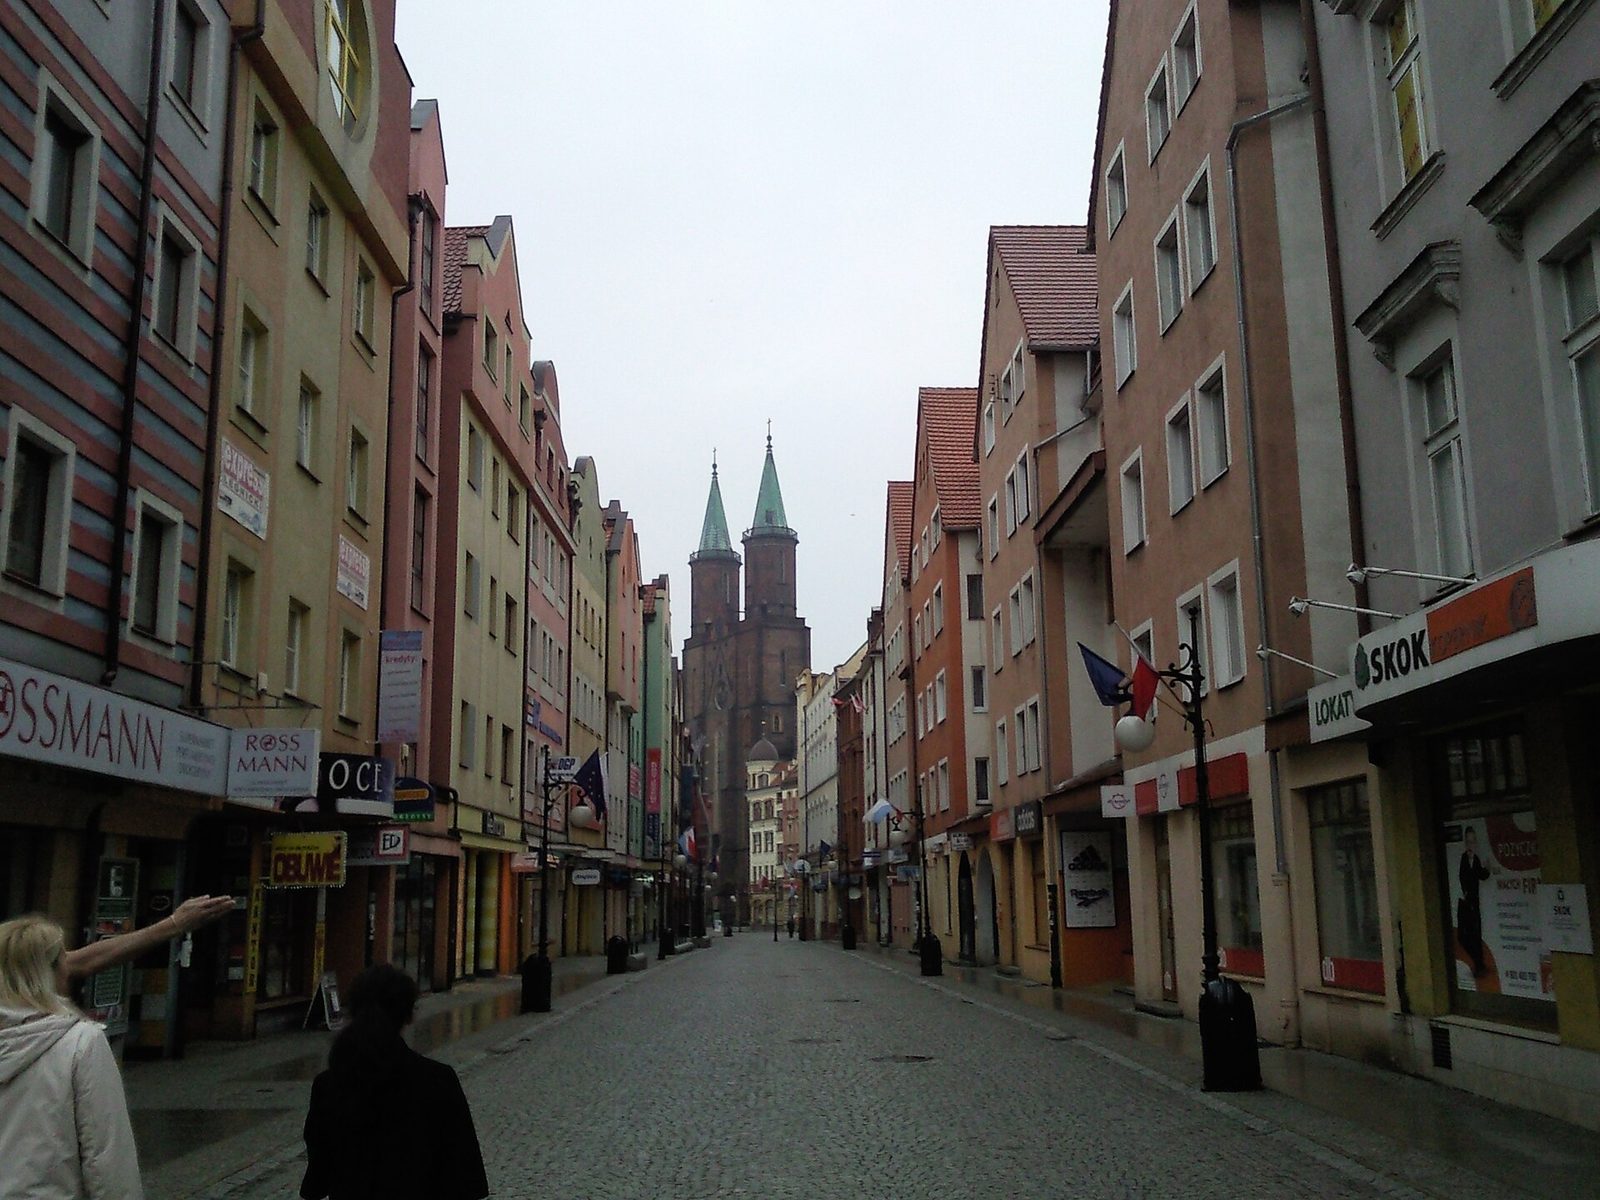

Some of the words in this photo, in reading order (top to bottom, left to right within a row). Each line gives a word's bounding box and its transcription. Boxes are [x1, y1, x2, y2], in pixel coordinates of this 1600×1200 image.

[1370, 629, 1430, 685] SKOK
[246, 734, 300, 752] ROSS
[237, 755, 307, 773] MANN
[318, 758, 383, 793] OCE
[1070, 888, 1110, 898] Reebok
